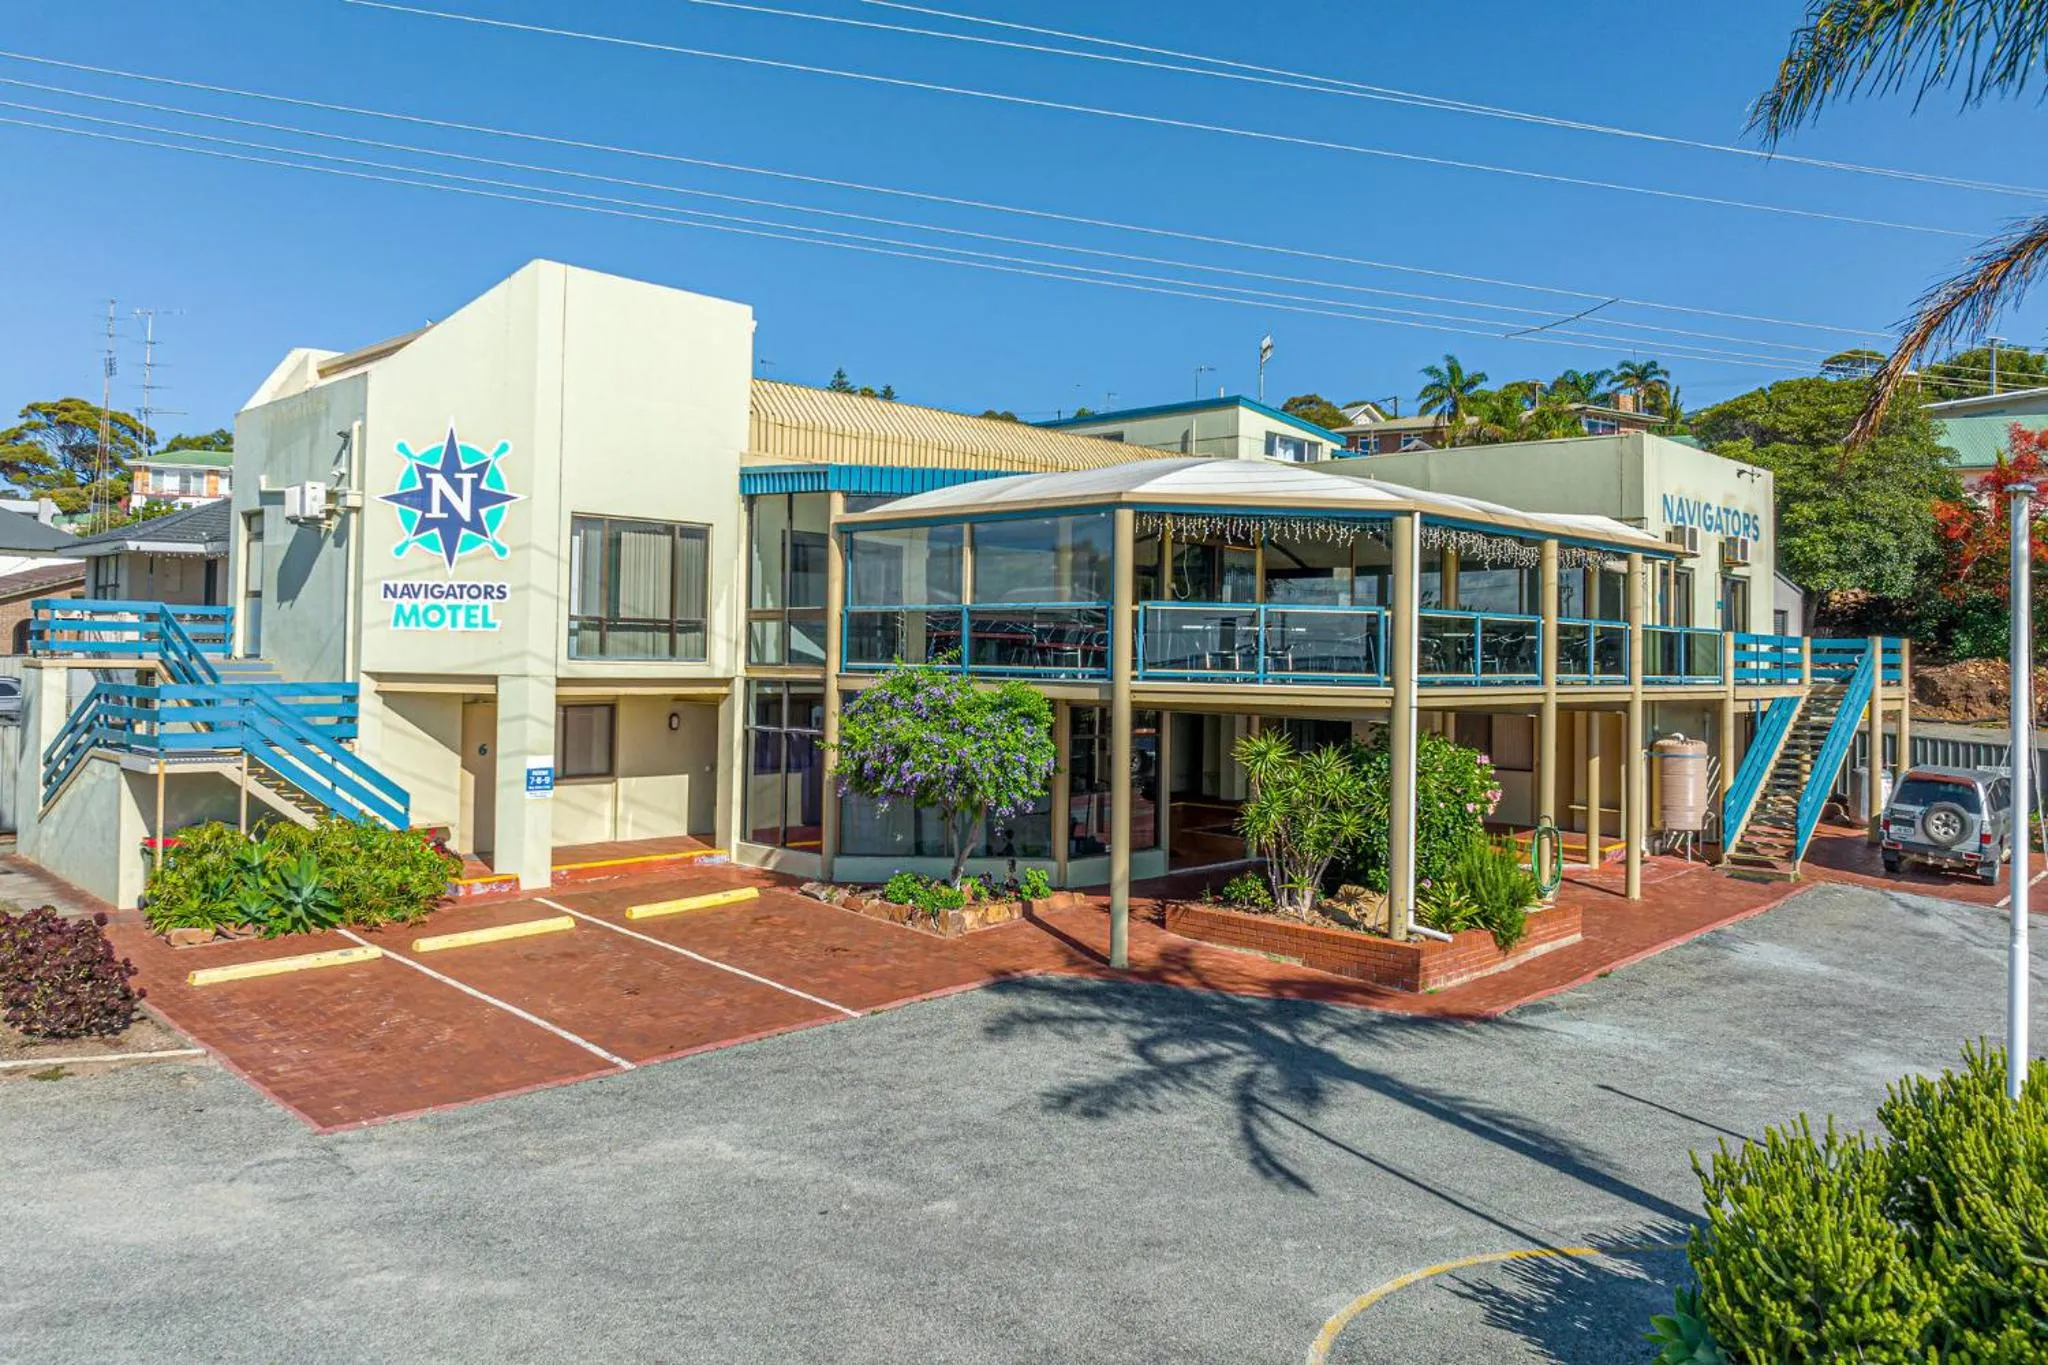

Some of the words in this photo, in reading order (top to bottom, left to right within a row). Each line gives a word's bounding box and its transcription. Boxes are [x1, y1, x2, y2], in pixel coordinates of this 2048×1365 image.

[425, 473, 478, 522] N
[1662, 493, 1760, 542] NAVIGATORS
[383, 583, 508, 600] NAVIGATORS
[393, 603, 497, 629] MOTEL
[479, 743, 488, 757] 6
